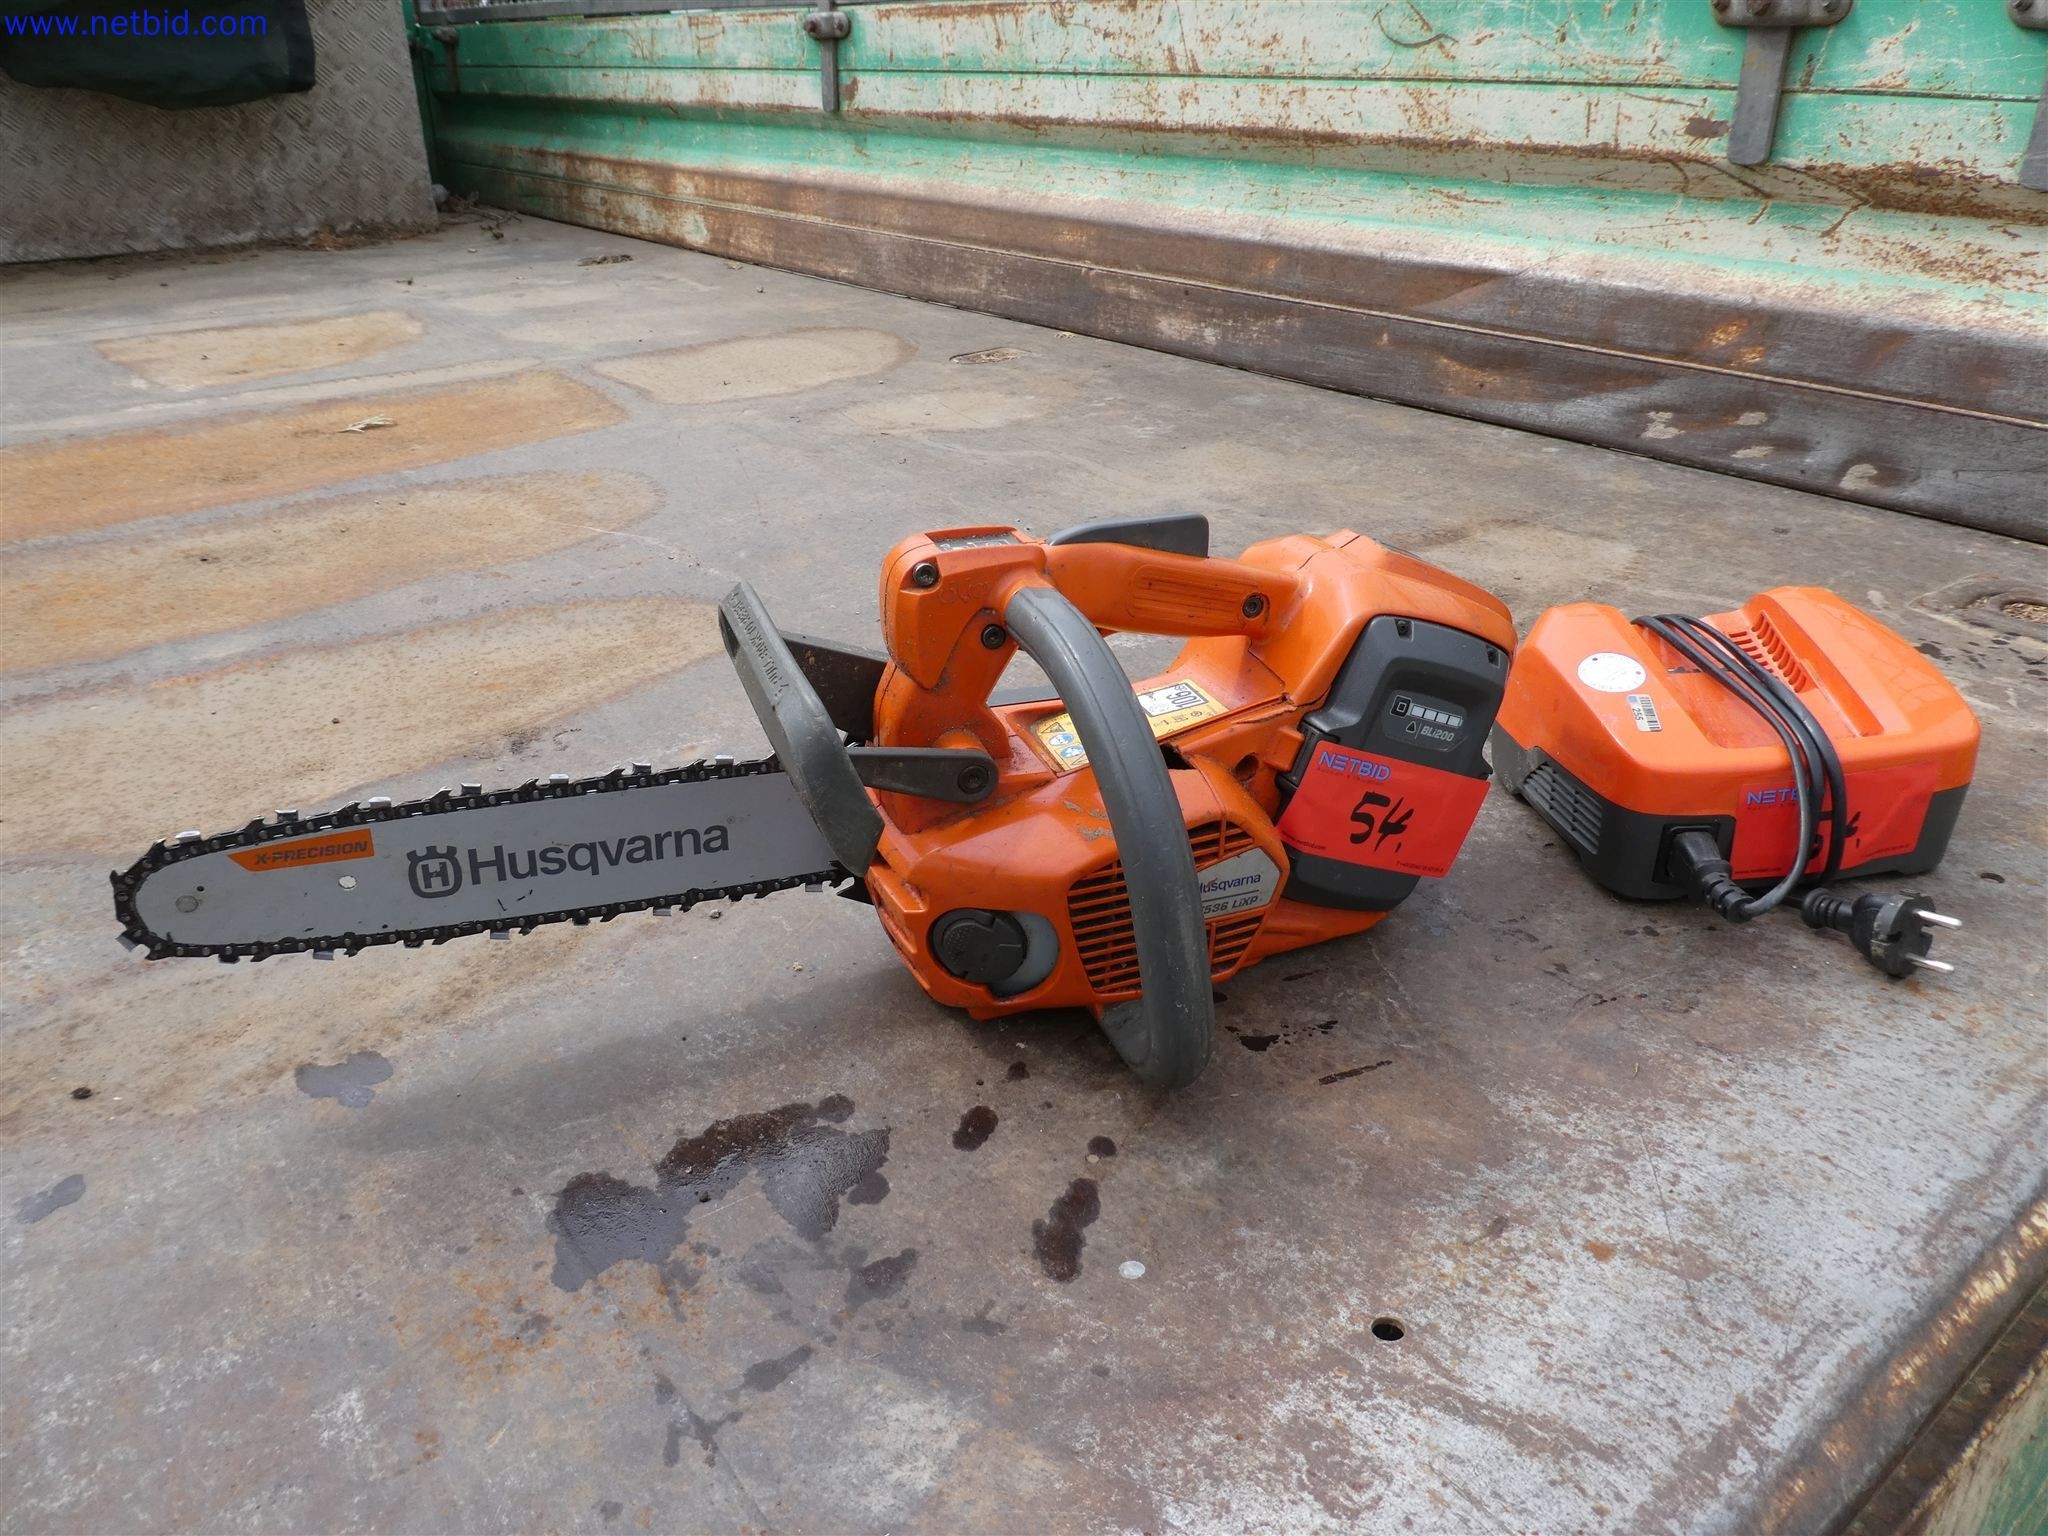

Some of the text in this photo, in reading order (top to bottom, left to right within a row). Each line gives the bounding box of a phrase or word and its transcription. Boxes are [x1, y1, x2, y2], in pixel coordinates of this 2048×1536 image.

[1420, 725, 1455, 742] BLi200
[1318, 751, 1391, 781] NETBID
[254, 840, 369, 866] X-PRECISION
[467, 824, 730, 886] Husqvarna
[1201, 901, 1229, 915] 536
